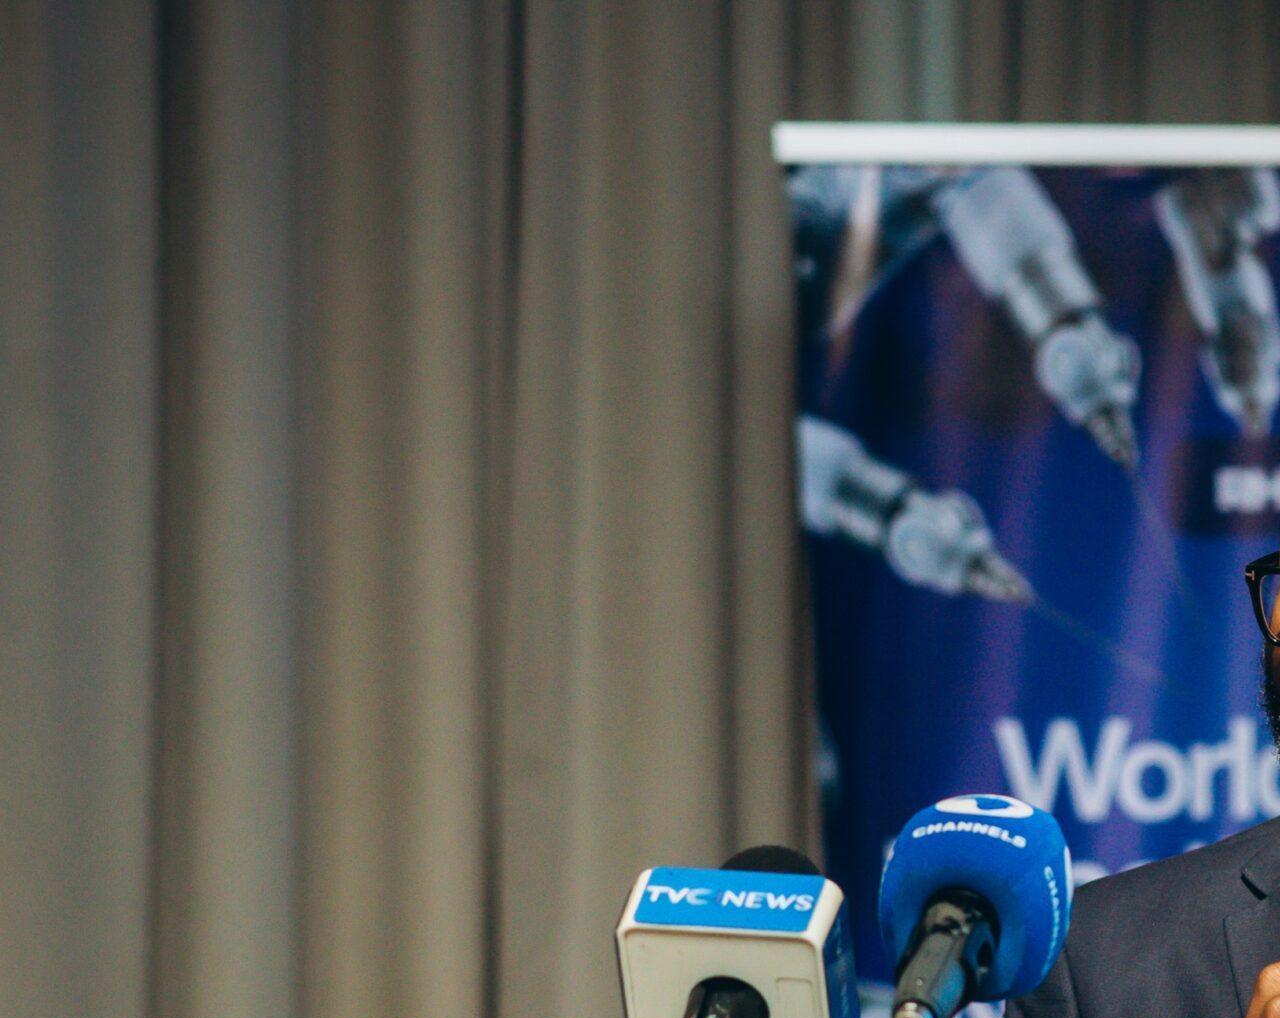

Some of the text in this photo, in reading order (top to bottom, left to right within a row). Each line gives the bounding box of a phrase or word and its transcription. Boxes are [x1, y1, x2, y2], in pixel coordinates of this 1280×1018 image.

[911, 820, 1027, 849] CHANNELS
[647, 885, 815, 912] TVC NEWS
